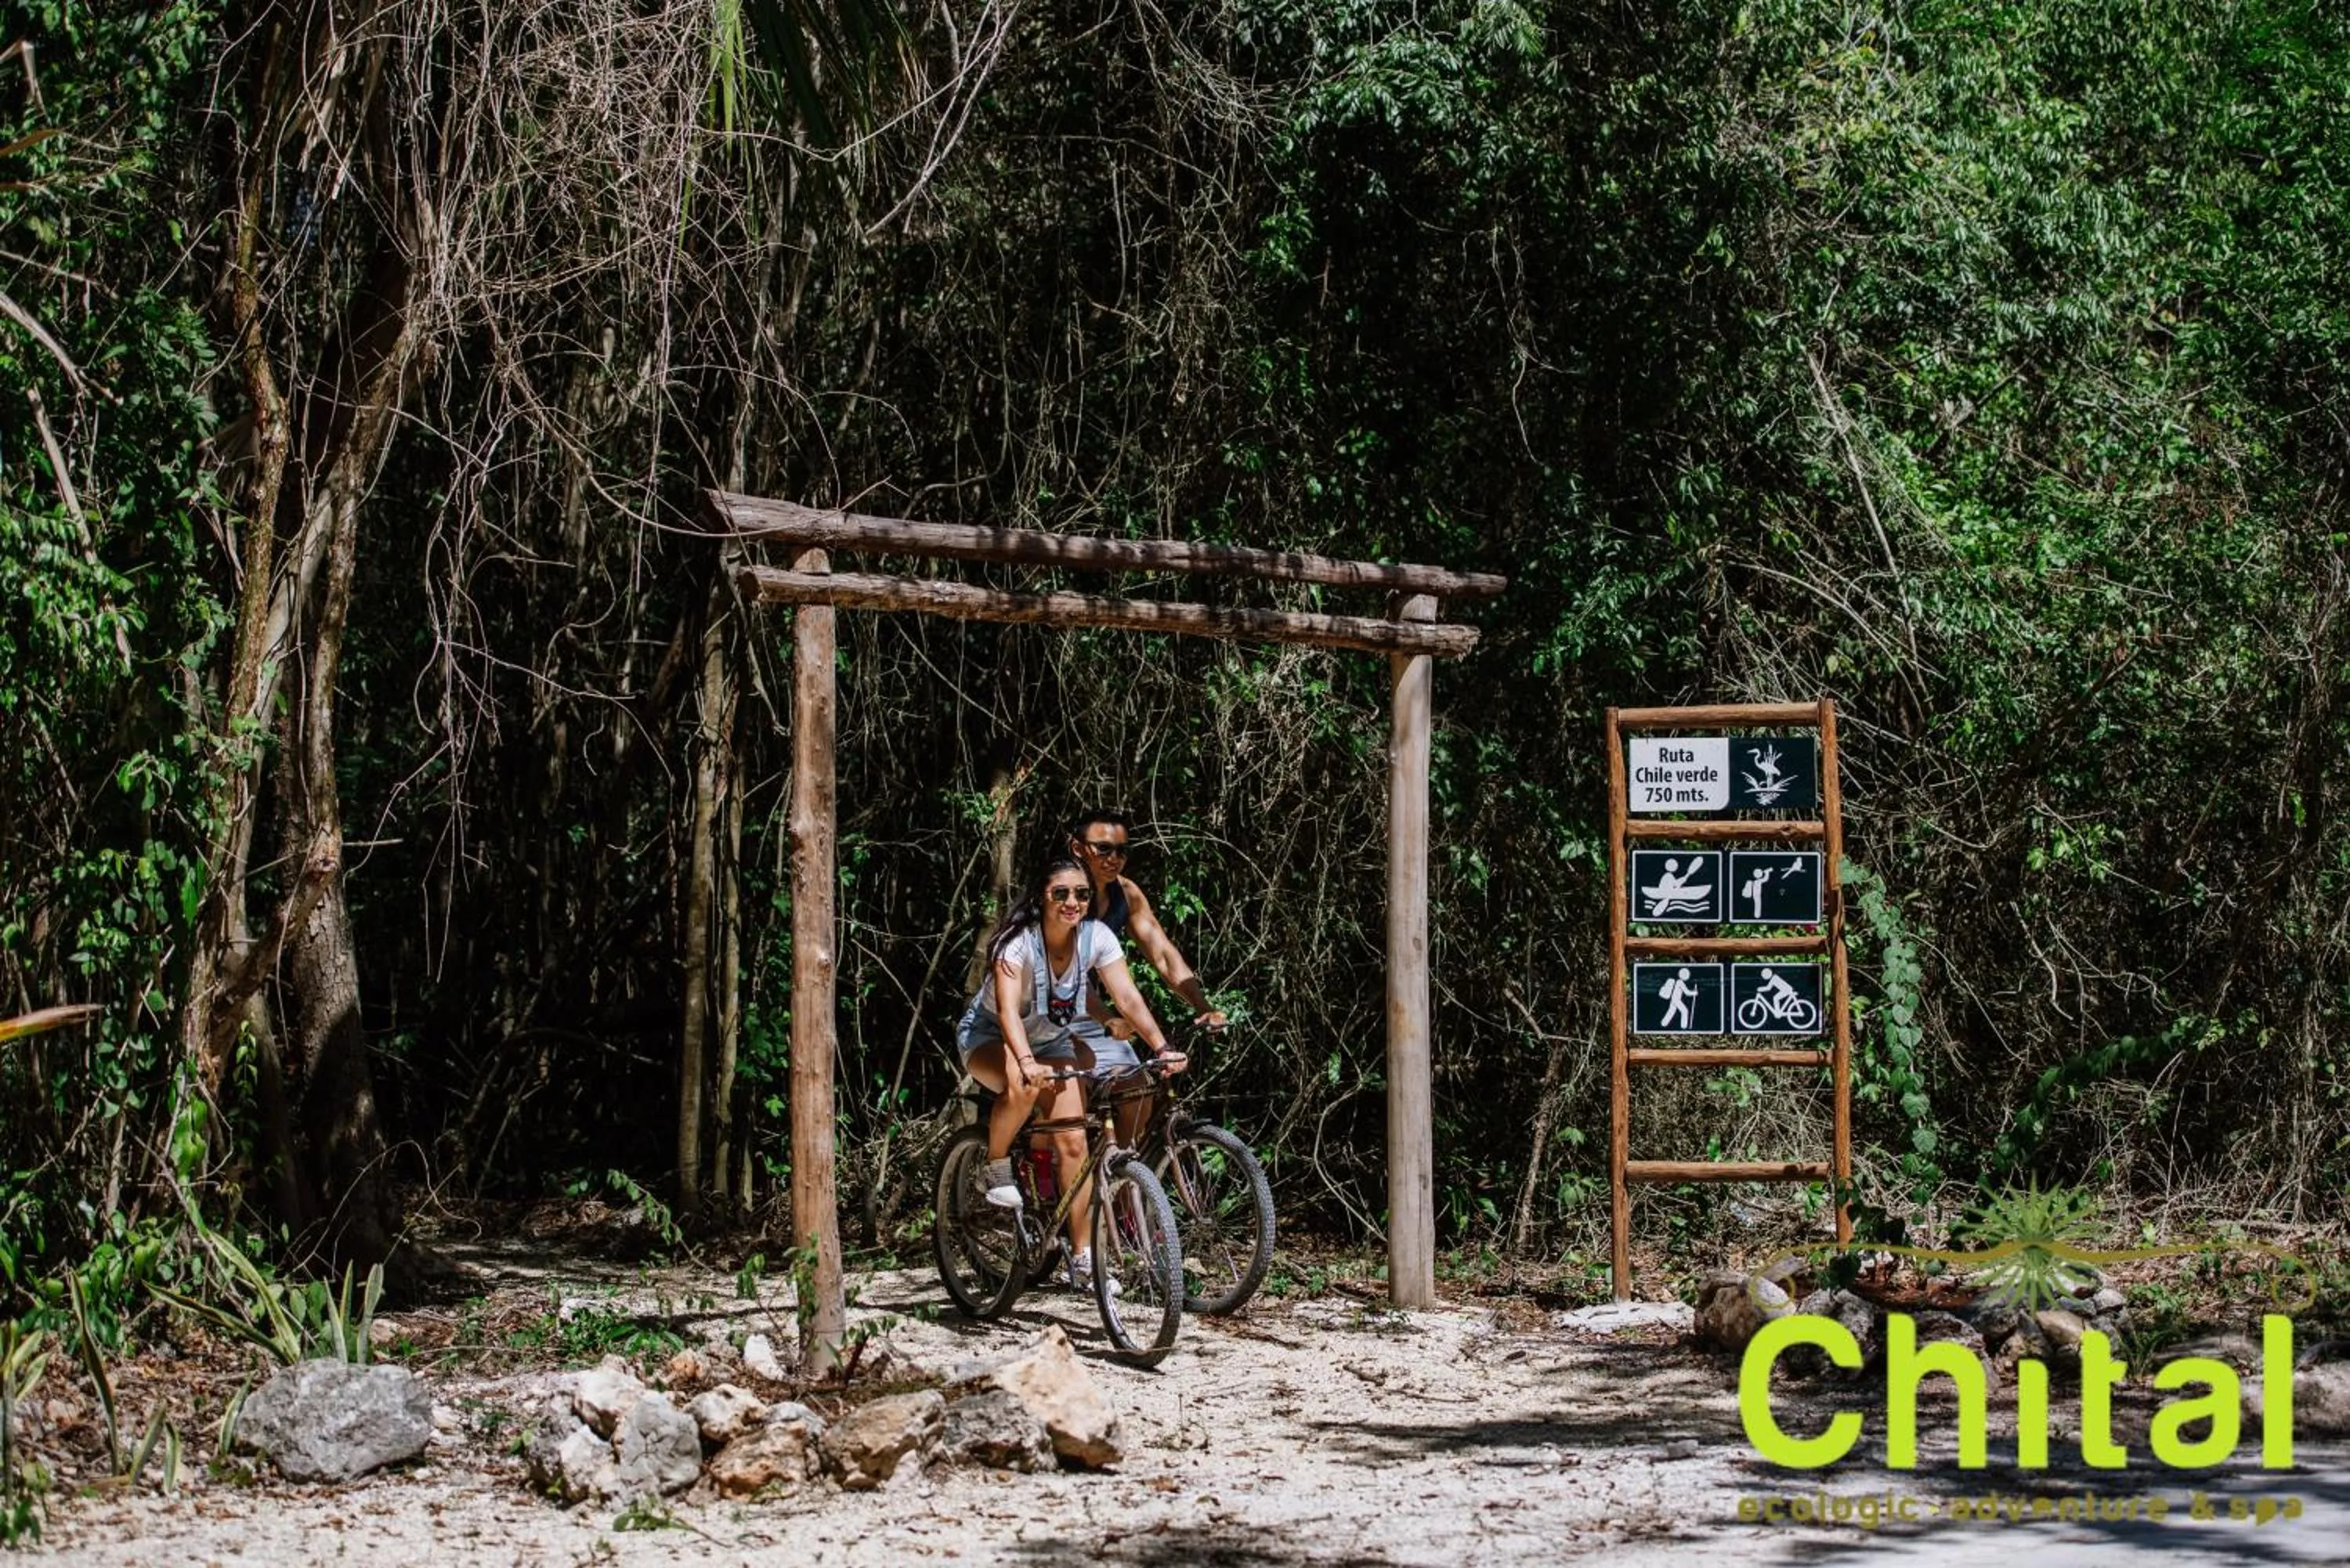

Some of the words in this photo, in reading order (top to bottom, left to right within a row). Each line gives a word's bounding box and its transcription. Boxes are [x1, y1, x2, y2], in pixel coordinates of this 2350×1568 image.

[1659, 747, 1694, 762] Ruta
[1636, 767, 1672, 782] Chile
[1676, 766, 1718, 782] verde
[1645, 787, 1672, 803] 750
[1676, 789, 1709, 802] mts.
